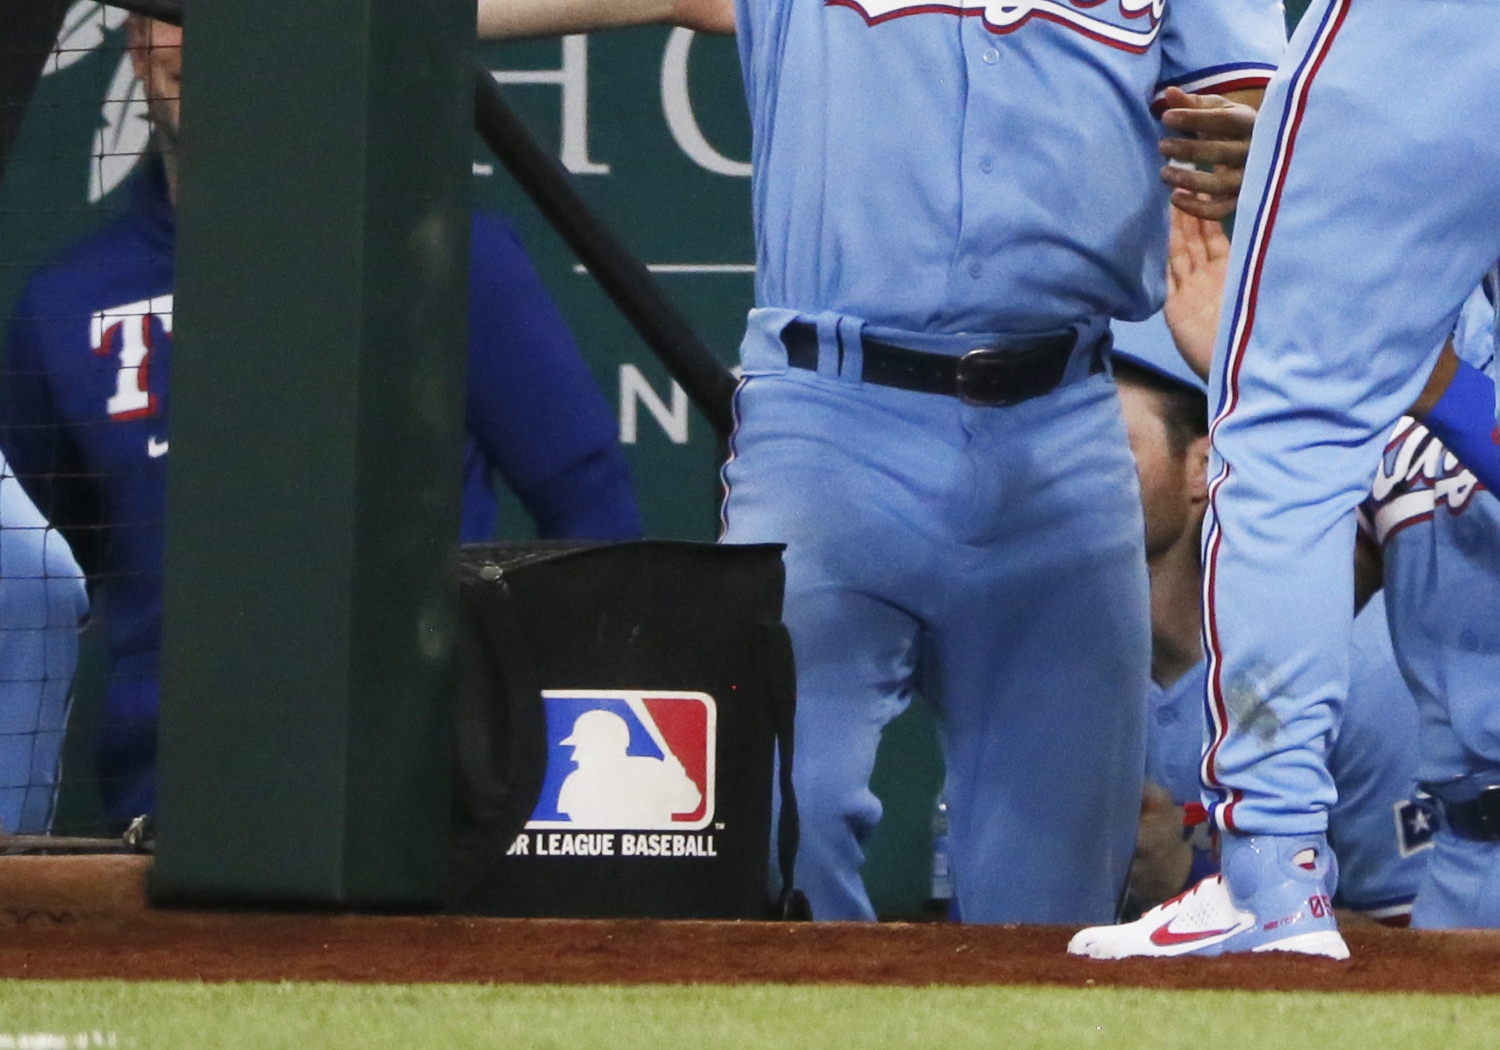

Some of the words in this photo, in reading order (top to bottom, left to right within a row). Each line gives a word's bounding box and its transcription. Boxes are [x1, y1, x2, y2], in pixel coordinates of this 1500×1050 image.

[90, 294, 173, 422] T
[536, 833, 615, 856] LEAGUE
[622, 834, 717, 857] BASEBALL
